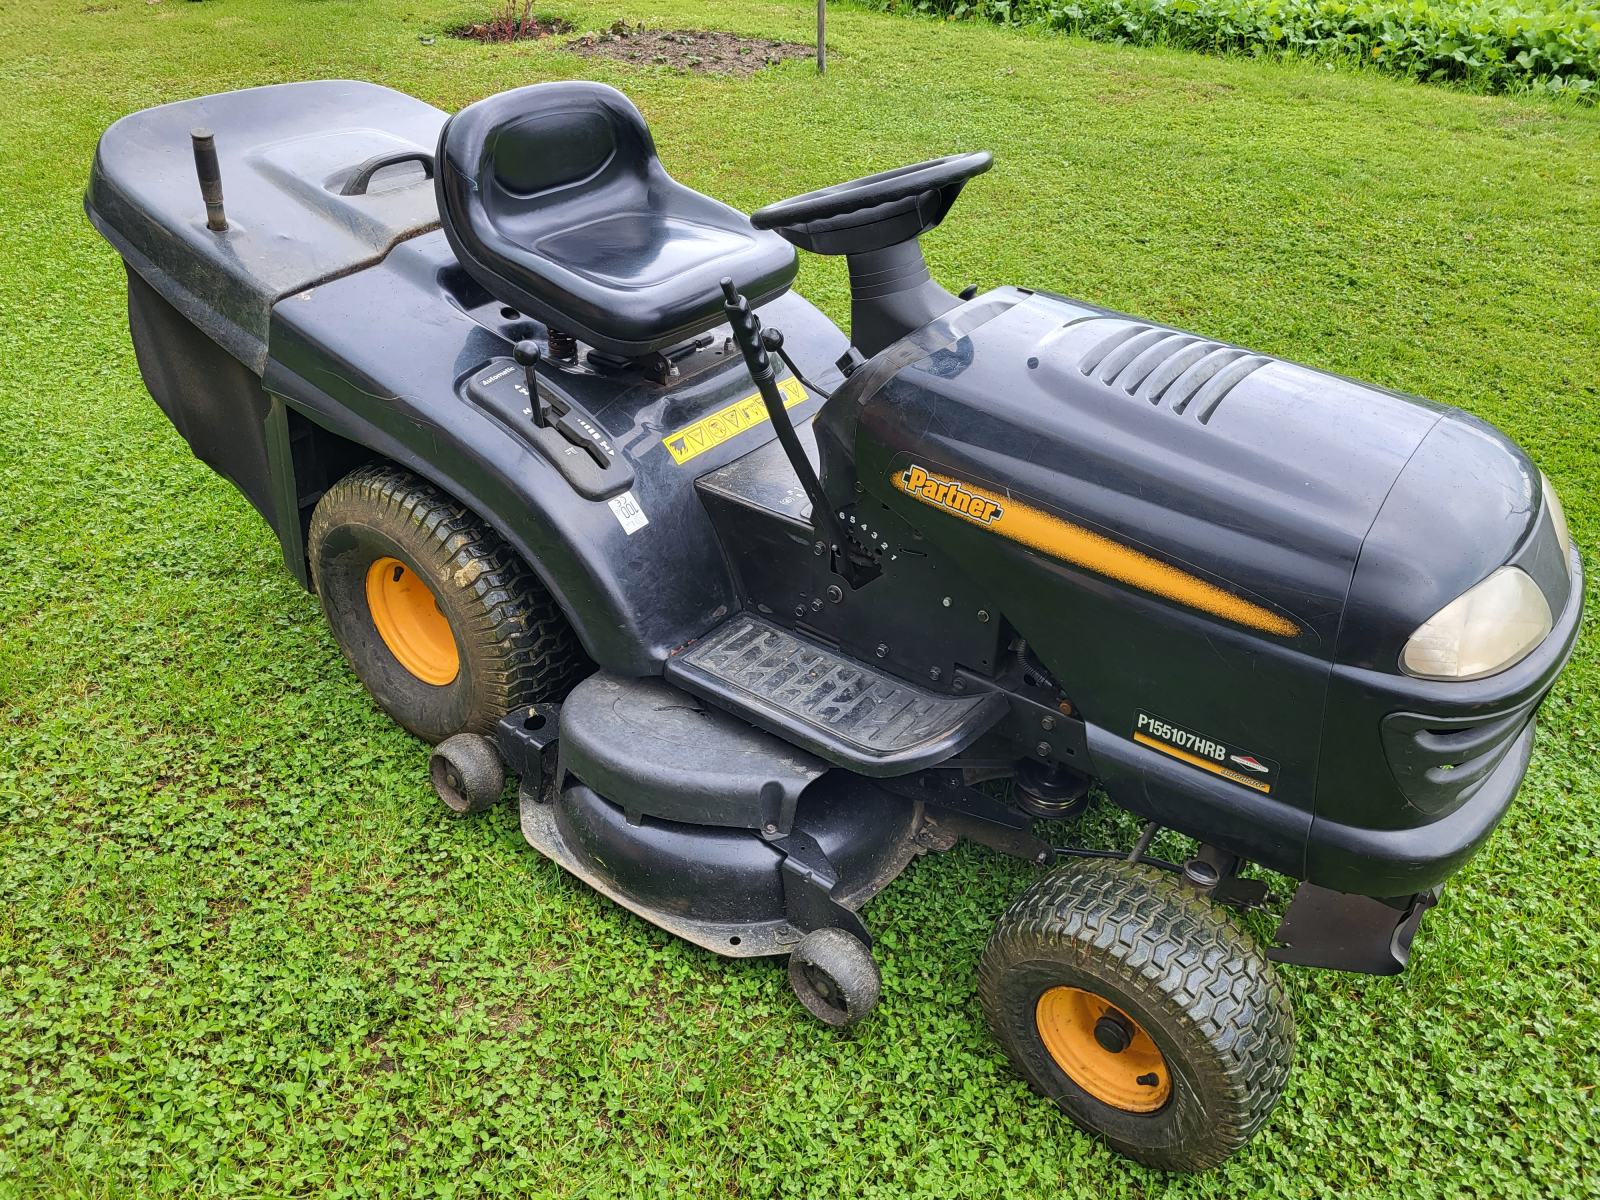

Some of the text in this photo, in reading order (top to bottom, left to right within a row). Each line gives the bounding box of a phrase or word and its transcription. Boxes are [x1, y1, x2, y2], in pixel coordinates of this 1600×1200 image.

[482, 366, 515, 386] Automatic
[904, 465, 1000, 523] Partner
[839, 511, 846, 520] 6
[849, 515, 856, 524] 5
[861, 523, 868, 531] 4
[871, 531, 878, 539] 3
[881, 541, 889, 550] 2
[1137, 713, 1226, 761] P155107HRB
